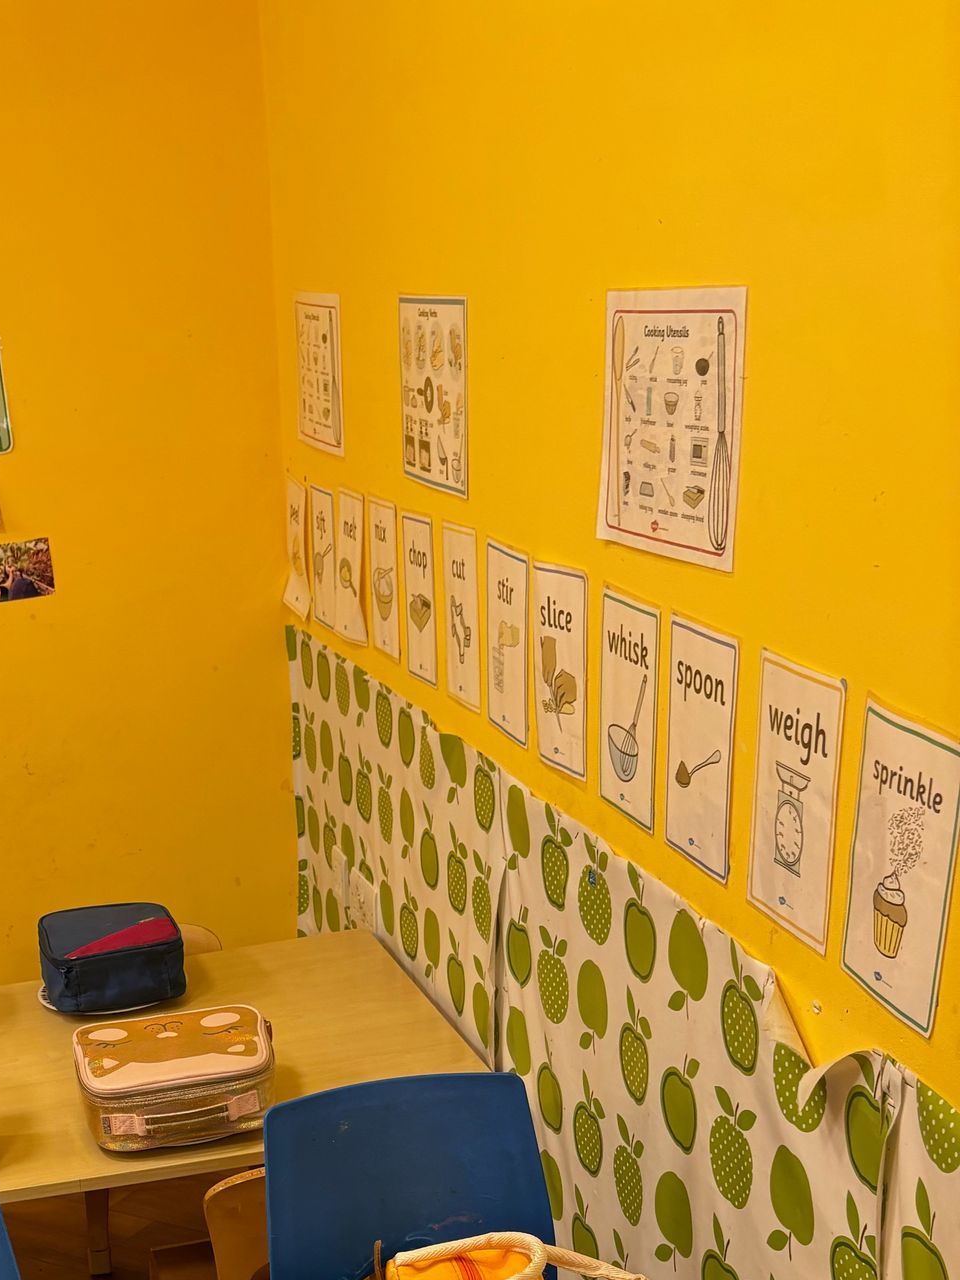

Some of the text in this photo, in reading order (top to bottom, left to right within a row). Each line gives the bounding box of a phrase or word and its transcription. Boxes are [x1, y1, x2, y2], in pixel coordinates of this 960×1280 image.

[643, 325, 690, 342] Cooking Utensils
[316, 510, 327, 541] sift
[343, 516, 358, 542] melt
[374, 519, 387, 544] mix
[409, 539, 428, 580] chop
[451, 558, 466, 581] cut
[497, 577, 514, 606] stir
[540, 595, 573, 633] slice
[607, 623, 650, 671] whisk
[676, 656, 726, 707] spoon
[768, 703, 828, 766] weigh
[872, 757, 944, 815] sprinkle
